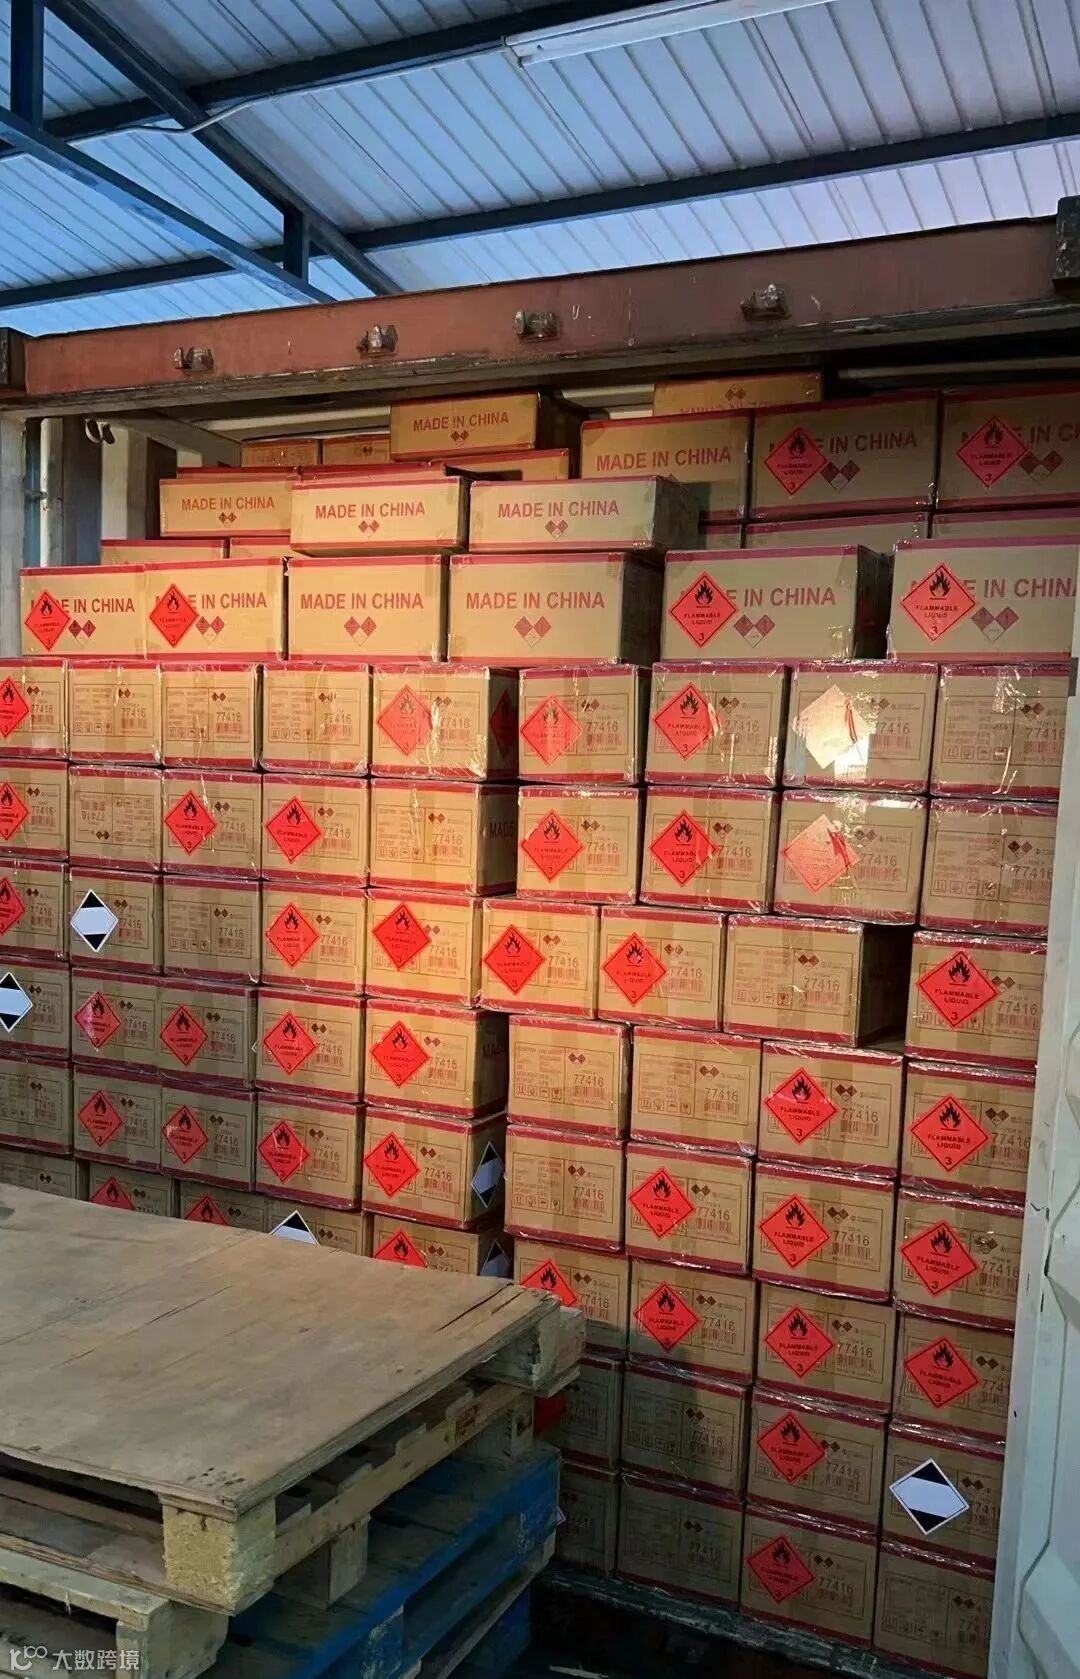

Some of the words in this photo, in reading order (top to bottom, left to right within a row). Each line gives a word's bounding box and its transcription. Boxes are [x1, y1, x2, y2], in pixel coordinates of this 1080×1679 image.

[413, 416, 448, 432] MADE
[451, 415, 465, 428] IN
[469, 412, 509, 427] CHINA
[1031, 424, 1052, 443] IN
[830, 435, 848, 454] IN
[855, 431, 918, 450] CHINA
[597, 451, 647, 471] MADE
[652, 450, 669, 467] IN
[675, 447, 731, 466] CHINA
[182, 498, 217, 511] MADE
[220, 497, 232, 510] IN
[236, 496, 274, 509] CHINA
[316, 504, 356, 519] MADE
[361, 503, 374, 518] IN
[379, 502, 425, 517] CHINA
[498, 503, 542, 518] MADE
[550, 502, 563, 516] IN
[568, 500, 619, 516] CHINA
[984, 578, 1004, 598] IN
[201, 594, 215, 609] IN
[220, 592, 267, 608] CHINA
[300, 593, 346, 609] MADE
[351, 593, 366, 609] IN
[372, 592, 424, 609] CHINA
[466, 592, 517, 609] MADE
[524, 592, 540, 609] IN
[546, 591, 605, 609] CHINA
[744, 588, 763, 606] IN
[770, 587, 836, 606] CHINA
[74, 599, 86, 612] IN
[91, 598, 135, 612] CHINA
[916, 604, 959, 612] FLAMMABLE
[120, 707, 146, 718] 77416
[216, 712, 241, 722] 77416
[586, 721, 618, 733] 77416
[219, 821, 246, 832] 77416
[432, 833, 462, 845] 77416
[587, 842, 618, 852] 77416
[860, 853, 897, 866] 77416
[217, 928, 243, 938] 77416
[320, 934, 348, 946] 77416
[429, 945, 457, 957] 77416
[548, 955, 578, 968] 77416
[804, 977, 840, 992] 77416
[934, 988, 980, 1000] FLAMMABLE
[943, 997, 969, 1006] LIQUID
[999, 1000, 1037, 1015] 77416
[574, 1074, 604, 1087] 77416
[704, 1087, 738, 1101] 77416
[841, 1108, 878, 1122] 77416
[927, 1134, 971, 1144] FLAMMABLE
[937, 1142, 961, 1150] LIQUID
[424, 1167, 452, 1182] 77416
[573, 1186, 604, 1200] 77416
[697, 1207, 730, 1221] 77416
[774, 1231, 814, 1243] FLAMMABLE
[783, 1239, 805, 1248] LIQUID
[832, 1230, 870, 1246] 77416
[916, 1256, 961, 1272] FLAMMABLE
[926, 1265, 949, 1276] LIQUID
[579, 1293, 609, 1309] 77416
[702, 1316, 735, 1332] 77416
[837, 1343, 873, 1358] 77416
